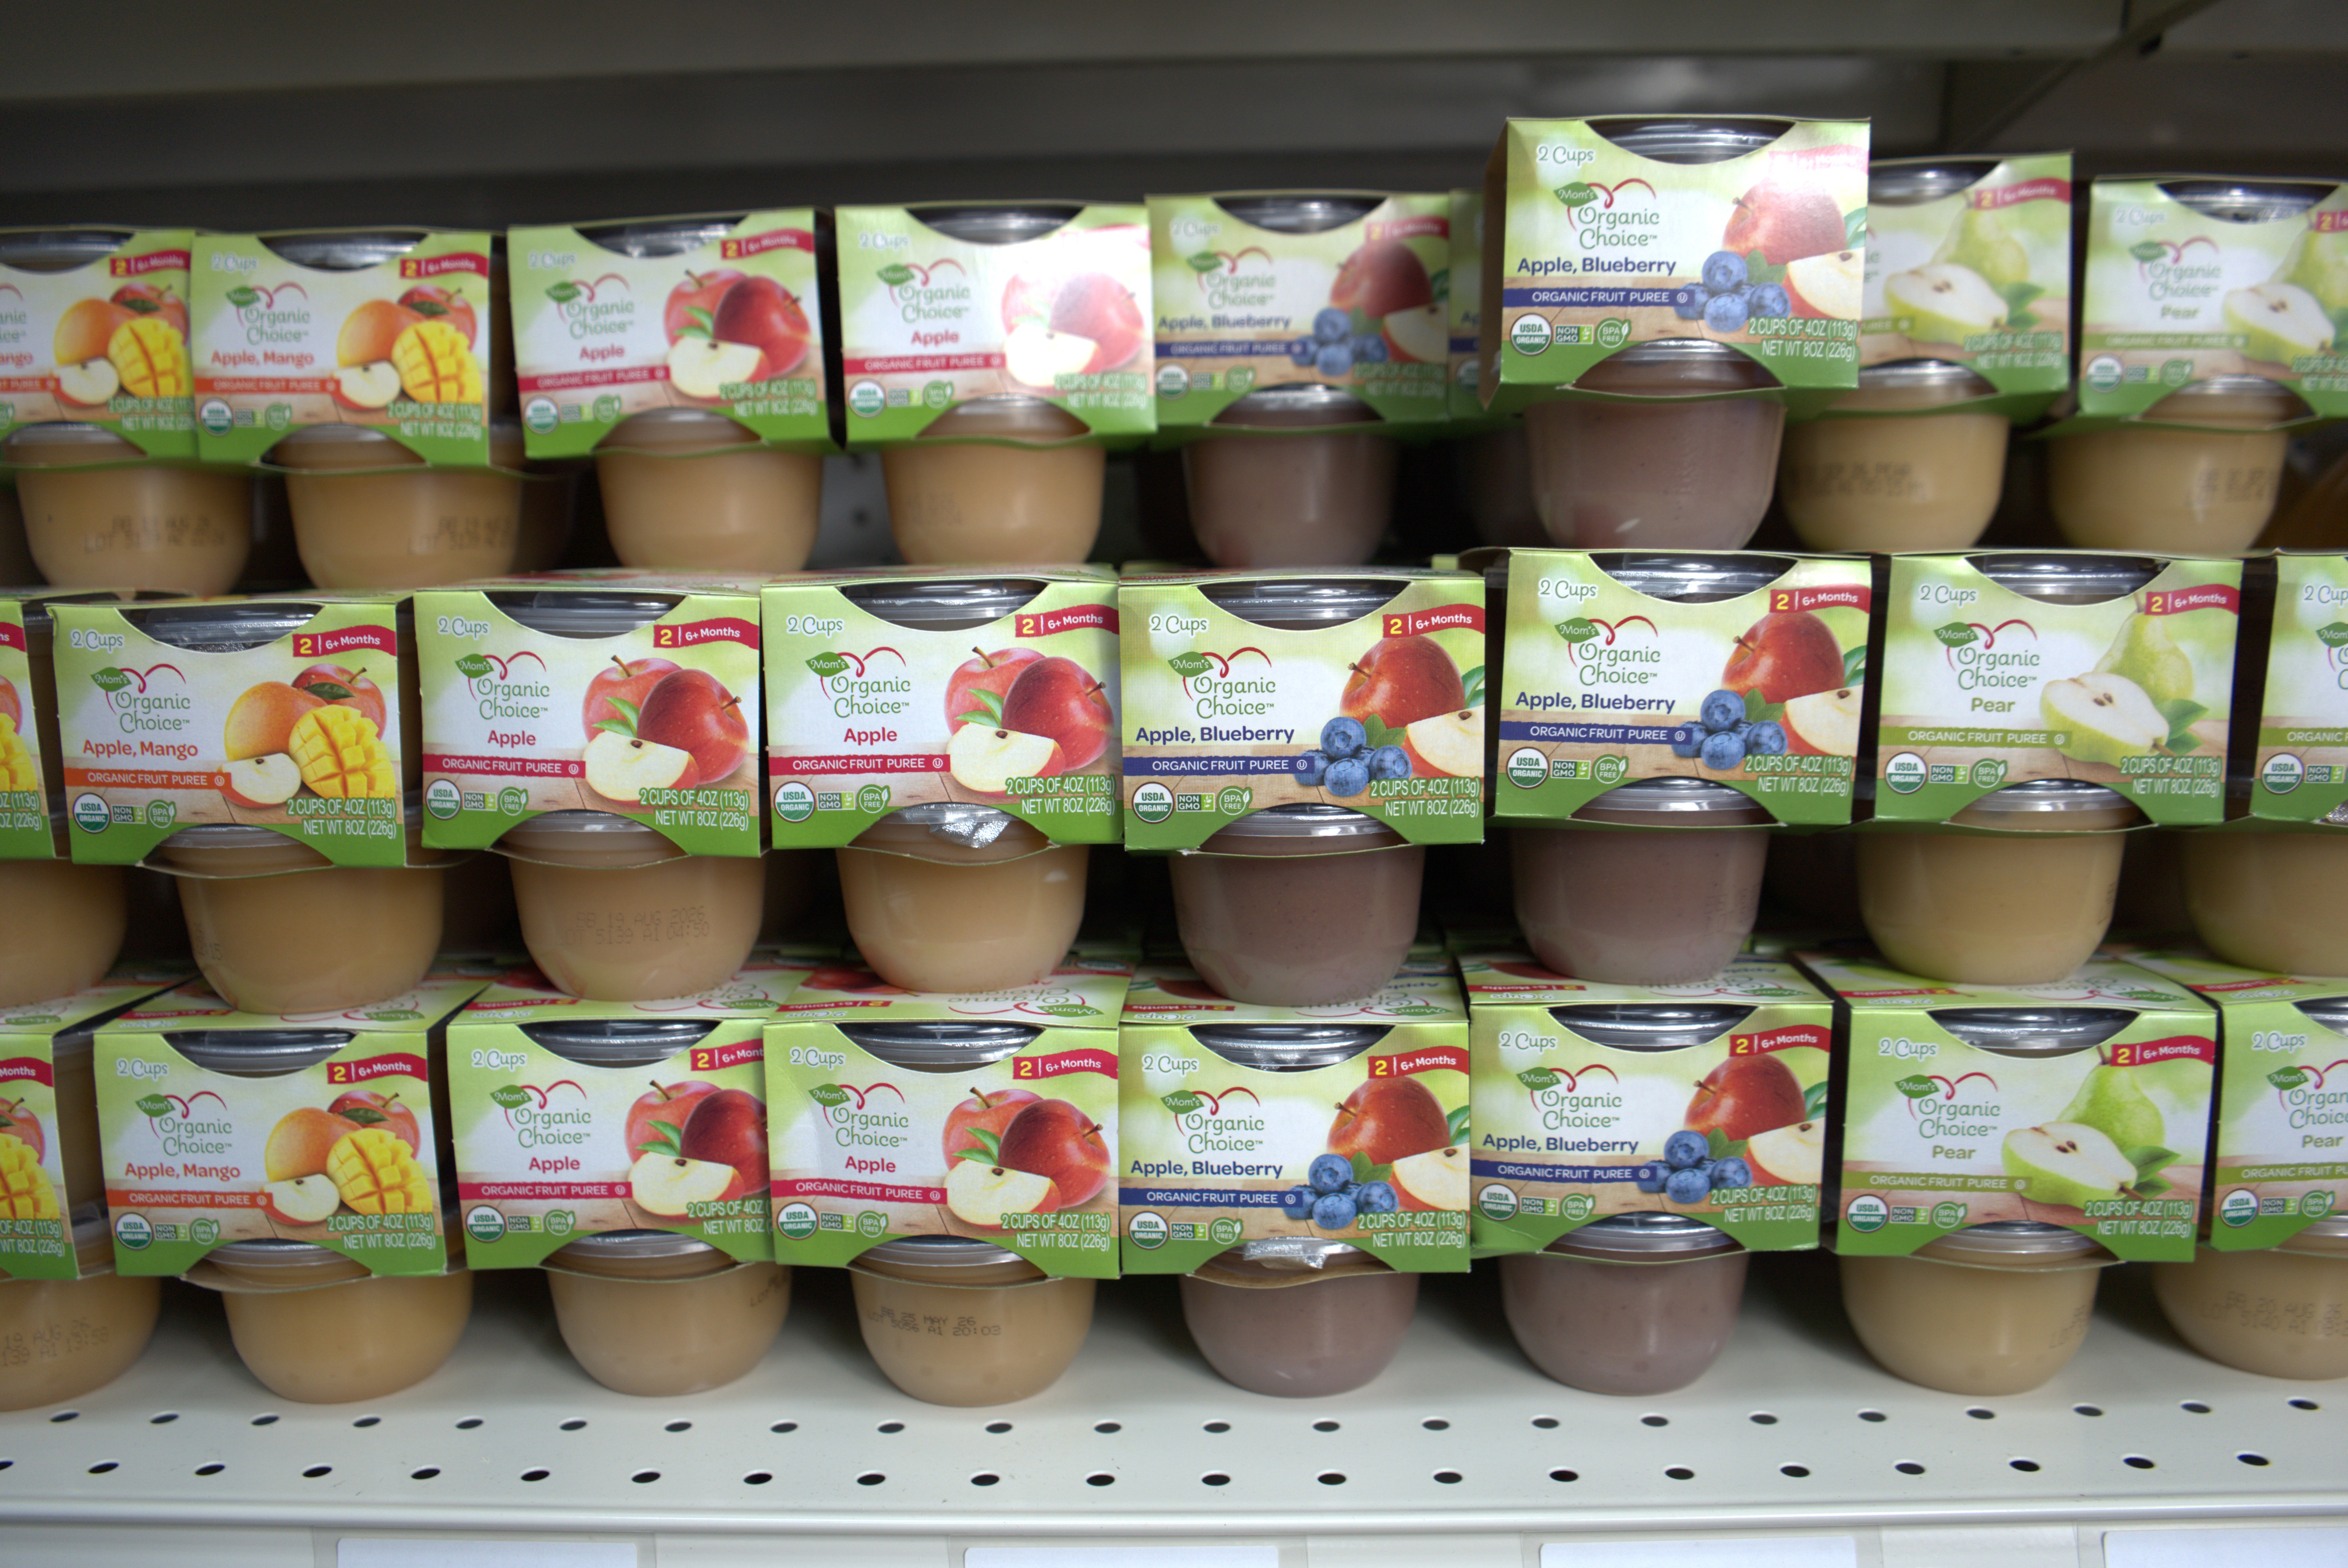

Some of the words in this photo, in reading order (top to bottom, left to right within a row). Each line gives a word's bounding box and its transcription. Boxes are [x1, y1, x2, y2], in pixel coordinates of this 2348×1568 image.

[1538, 146, 1549, 160] 2
[1553, 146, 1594, 166] Cups
[1559, 189, 1593, 199] Mom's
[1578, 207, 1659, 231] Organic
[1517, 256, 1577, 277] Apple,
[1582, 256, 1676, 276] Blueberry
[899, 285, 971, 305] Organic
[1533, 291, 1589, 302] ORGANIC
[1591, 291, 1625, 302] FRUIT
[1630, 291, 1669, 302] PUREE
[244, 308, 311, 328] Organic
[566, 298, 635, 322] Organic
[911, 329, 959, 346] Apple
[1520, 323, 1544, 333] USDA
[212, 350, 261, 367] Apple,
[262, 351, 315, 369] Mango
[579, 343, 625, 362] Apple
[1762, 340, 1783, 356] NET
[1785, 341, 1802, 356] WT
[1803, 341, 1824, 357] 8OZ
[1826, 341, 1856, 362] (226g)
[1151, 616, 1161, 630] 2
[1166, 616, 1207, 636] Cups
[1390, 619, 1402, 634] 2
[1416, 620, 1430, 629] 6+
[1431, 614, 1472, 625] Months
[72, 631, 82, 645] 2
[85, 631, 124, 652] Cups
[1939, 629, 1975, 639] Mom's
[300, 638, 313, 654] 2
[325, 640, 339, 650] 6+
[339, 634, 382, 647] Months
[1174, 659, 1208, 668] Mom's
[1578, 643, 1661, 669] Organic
[1957, 646, 2039, 673] Organic
[95, 675, 127, 684] Mom's
[830, 676, 911, 698] Organic
[1194, 676, 1276, 699] Organic
[476, 679, 550, 703] Organic
[115, 692, 191, 715] Organic
[1516, 690, 1577, 712] Apple,
[1581, 693, 1676, 714] Blueberry
[1971, 697, 2015, 713] Pear
[486, 728, 538, 749] Apple
[843, 726, 898, 745] Apple
[1136, 727, 1195, 745] Apple,
[1201, 726, 1294, 743] Blueberry
[83, 740, 138, 758] Apple,
[140, 741, 198, 761] Mango
[1152, 761, 1208, 770] ORGANIC
[1211, 761, 1245, 770] FRUIT
[1250, 760, 1289, 770] PUREE
[1142, 792, 1165, 801] USDA
[1371, 782, 1377, 796] 2
[1380, 780, 1409, 796] CUPS
[1411, 780, 1425, 795] OF
[1428, 779, 1448, 794] 4OZ
[1451, 778, 1480, 797] (113g)
[2133, 779, 2153, 794] NET
[2154, 779, 2169, 793] WT
[2171, 779, 2190, 793] 8OZ
[2192, 779, 2219, 797] (226g)
[1386, 801, 1406, 816] NET
[1409, 801, 1425, 815] WT
[1427, 800, 1447, 814] 8OZ
[1450, 799, 1479, 818] (226g)
[634, 911, 661, 926] AUG
[670, 906, 704, 925] 2026
[1501, 1033, 1511, 1046] 2
[1515, 1033, 1556, 1052] Cups
[1881, 1039, 1891, 1053] 2
[1895, 1040, 1937, 1060] Cups
[791, 1050, 800, 1063] 2
[805, 1049, 844, 1069] Cups
[1020, 1061, 1032, 1076] 2
[1045, 1063, 1059, 1072] 6+
[1060, 1058, 1102, 1070] Months
[2270, 1073, 2305, 1083] Mom's
[813, 1090, 846, 1100] Mom's
[1541, 1091, 1622, 1112] Organic
[139, 1101, 171, 1110] Mom's
[1918, 1099, 2001, 1122] Organic
[515, 1108, 591, 1129] Organic
[833, 1107, 909, 1130] Organic
[1185, 1114, 1264, 1135] Organic
[158, 1118, 233, 1139] Organic
[1482, 1134, 1542, 1152] Apple,
[1546, 1137, 1639, 1154] Blueberry
[2301, 1132, 2344, 1150] Pear
[1931, 1144, 1976, 1160] Pear
[126, 1162, 180, 1180] Apple,
[182, 1163, 241, 1182] Mango
[528, 1155, 581, 1173] Apple
[845, 1156, 896, 1174] Apple
[1130, 1160, 1188, 1178] Apple,
[1192, 1161, 1283, 1178] Blueberry
[797, 1181, 849, 1193] ORGANIC
[850, 1186, 882, 1196] FRUIT
[886, 1188, 923, 1199] PUREE
[787, 1211, 808, 1220] USDA
[1003, 1213, 1009, 1227] 2
[1011, 1213, 1040, 1229] CUPS
[1042, 1214, 1056, 1229] OF
[1058, 1214, 1079, 1229] 4OZ
[1081, 1213, 1110, 1233] (113g)
[785, 1222, 812, 1230] ORGANIC
[1017, 1233, 1038, 1248] NET
[1040, 1233, 1056, 1247] WT
[1058, 1233, 1078, 1248] 8OZ
[1081, 1233, 1110, 1252] (226g)
[901, 1312, 916, 1323] 25
[923, 1316, 949, 1325] MAY
[957, 1317, 976, 1326] 26
[928, 1327, 943, 1335] A1
[953, 1326, 1001, 1336] 20:03
